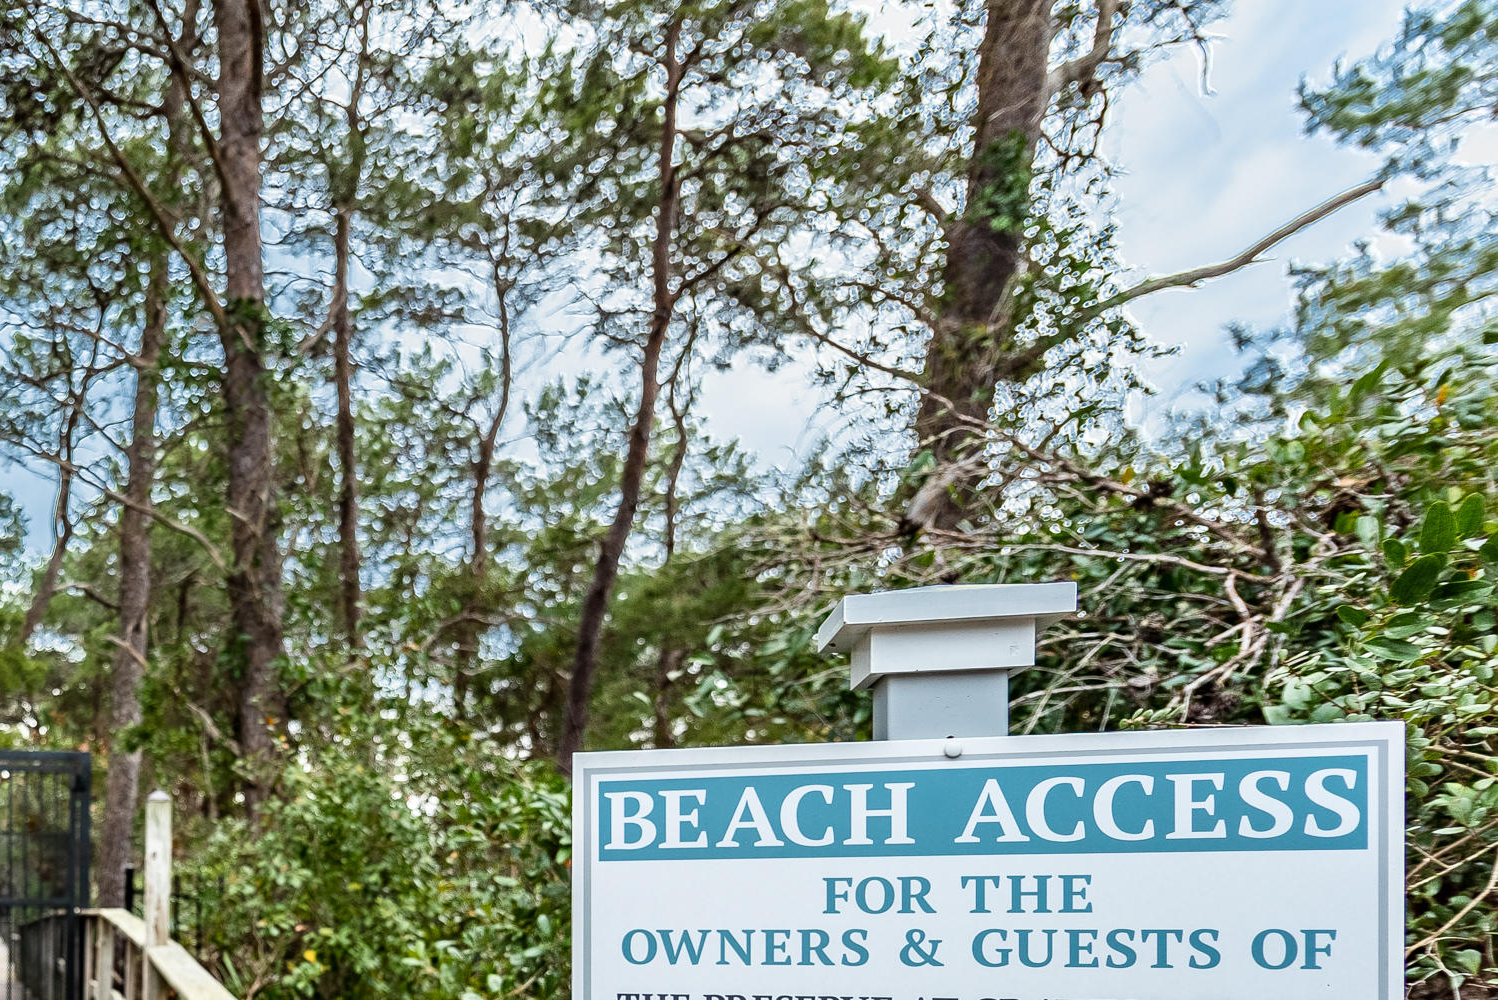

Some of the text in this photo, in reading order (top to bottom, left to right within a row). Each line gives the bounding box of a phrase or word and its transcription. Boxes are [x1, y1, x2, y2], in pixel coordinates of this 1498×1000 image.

[602, 767, 1361, 852] BEACH ACCESS
[822, 874, 1093, 915] FOR THE
[621, 928, 1337, 970] OWNERS & GUESTS OF
